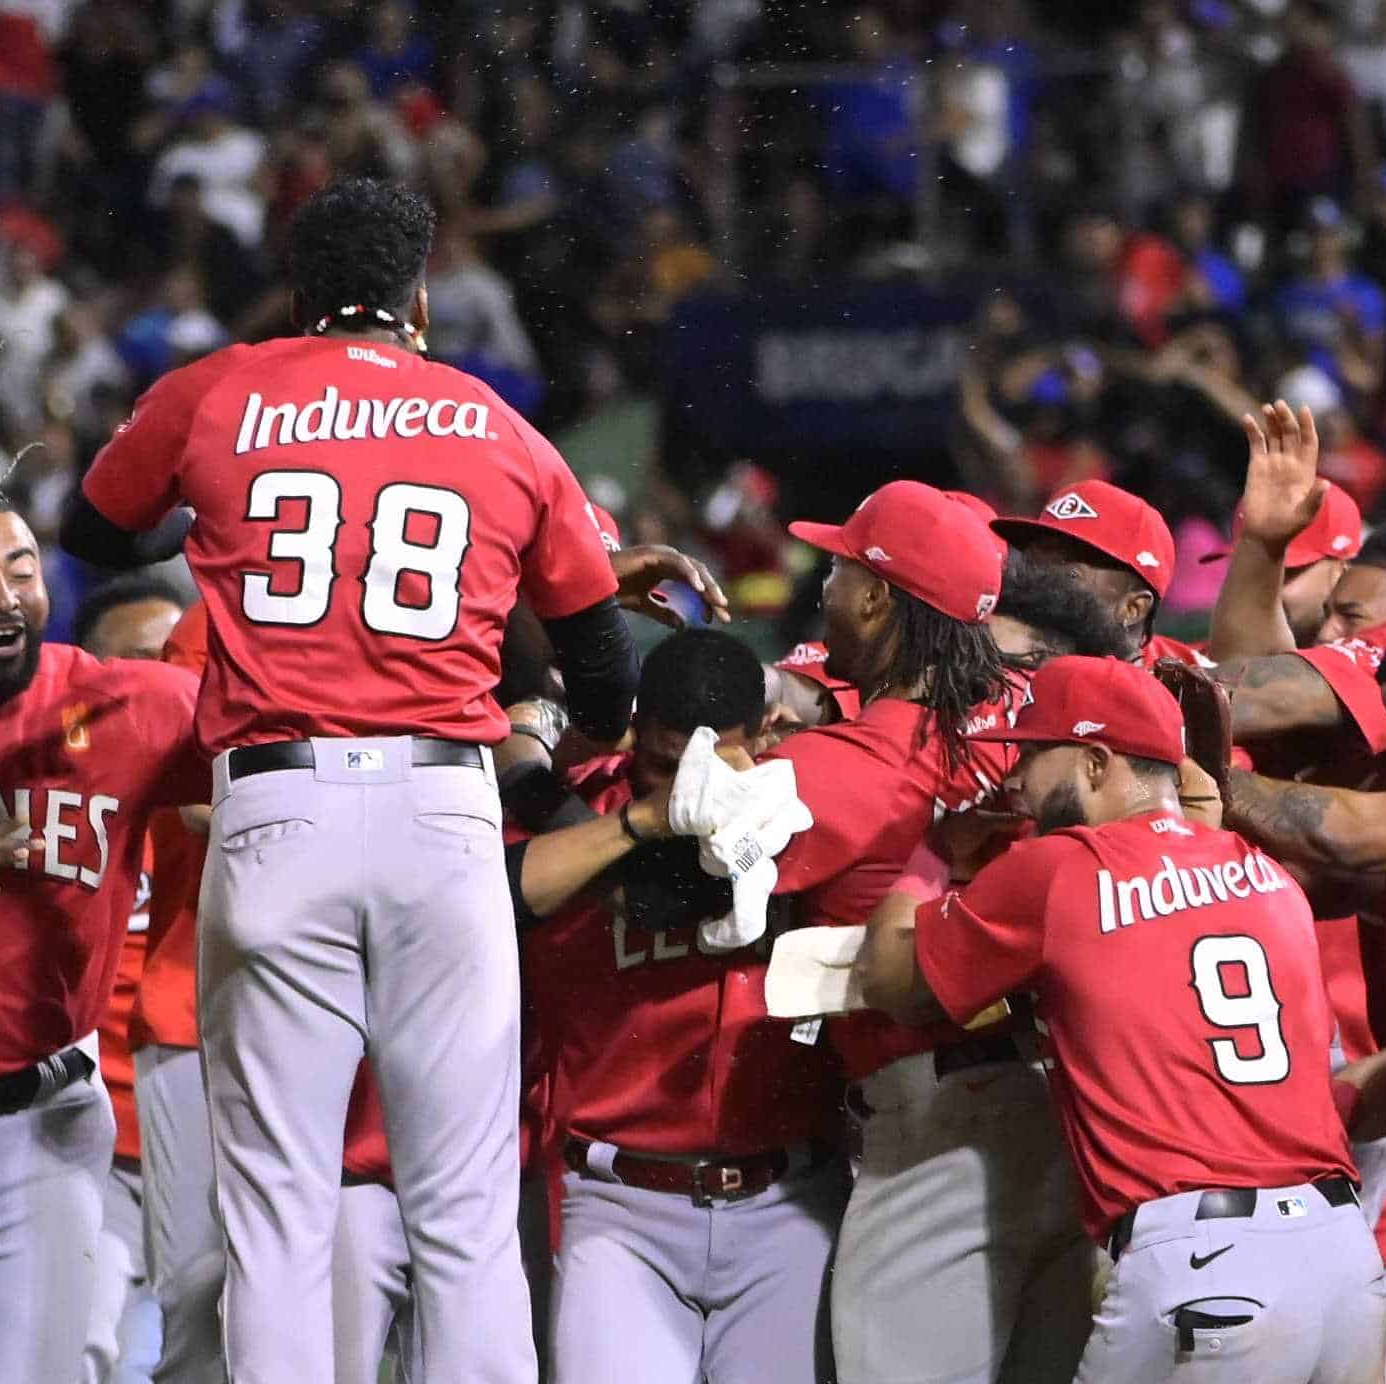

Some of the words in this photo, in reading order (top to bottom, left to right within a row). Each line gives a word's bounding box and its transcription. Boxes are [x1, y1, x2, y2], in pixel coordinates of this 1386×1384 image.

[234, 385, 490, 456] Induveca
[239, 467, 473, 644] 38
[1189, 934, 1291, 1087] 9
